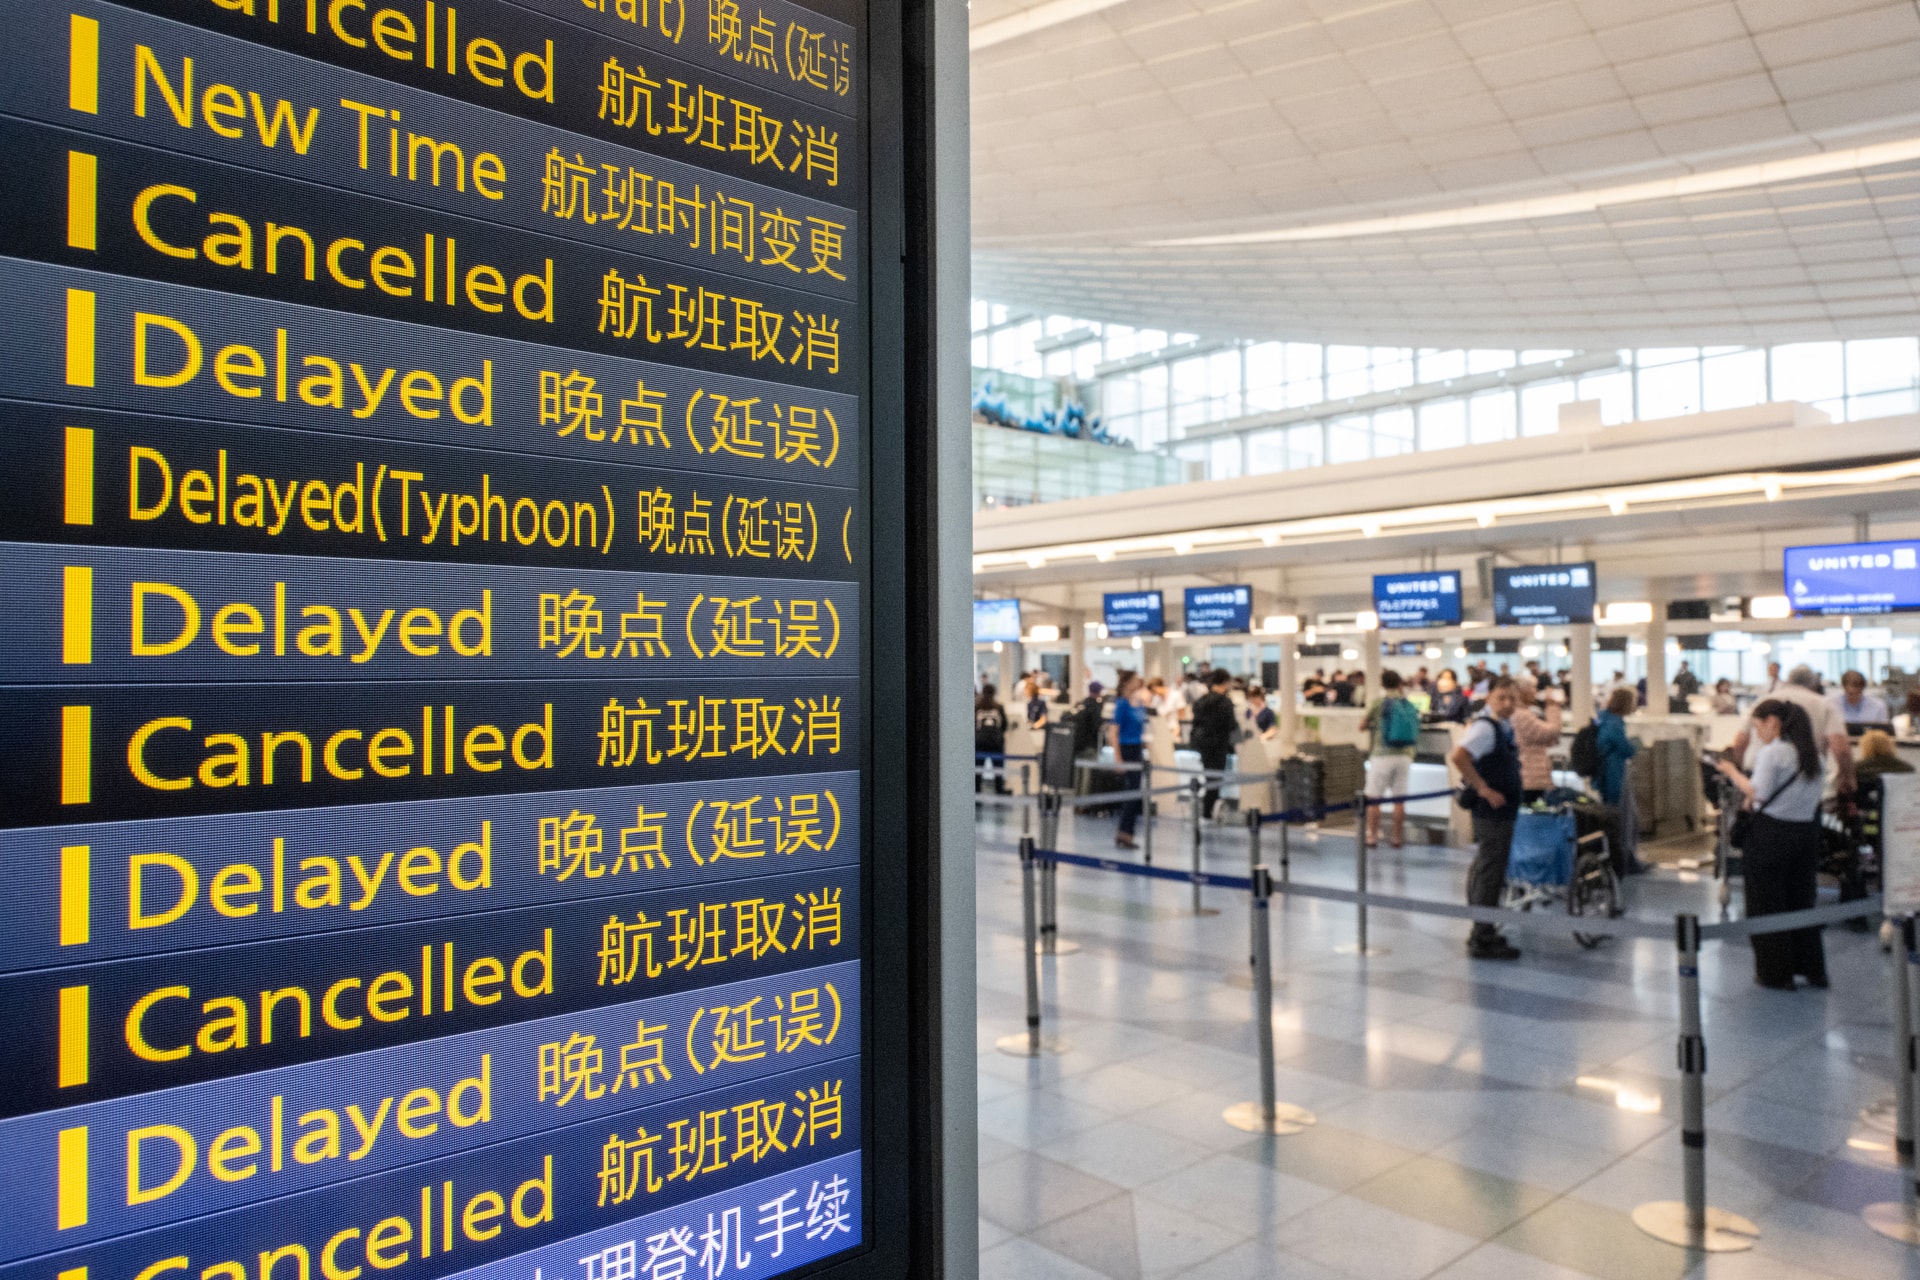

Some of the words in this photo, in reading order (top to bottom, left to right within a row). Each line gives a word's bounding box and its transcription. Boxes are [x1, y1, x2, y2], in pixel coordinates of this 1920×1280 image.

[133, 43, 320, 156] New
[340, 98, 507, 201] Time
[597, 55, 838, 187] 航班取消
[132, 183, 554, 324] Cancelled
[541, 146, 846, 281] 航班时间变更
[133, 311, 493, 427] Delayed
[597, 268, 839, 375] 航班取消
[539, 369, 840, 468] 晚点(延误)
[129, 445, 615, 555] Delayed(Typhoon)
[1387, 580, 1439, 594] UNITED
[1509, 572, 1569, 588] UNITED
[1809, 554, 1891, 571] UNITED
[130, 581, 493, 664] Delayed
[538, 588, 841, 659] 晚点(延误)
[127, 703, 554, 791] Cancelled
[596, 694, 841, 768] 航班取消
[128, 820, 492, 930] Delayed
[538, 790, 841, 882] 晚点(延误)
[596, 887, 842, 987] 航班取消
[124, 927, 554, 1062] Cancelled
[538, 983, 842, 1107] 晚点(延误)
[126, 1053, 491, 1206] Delayed
[597, 1079, 842, 1207] 航班取消
